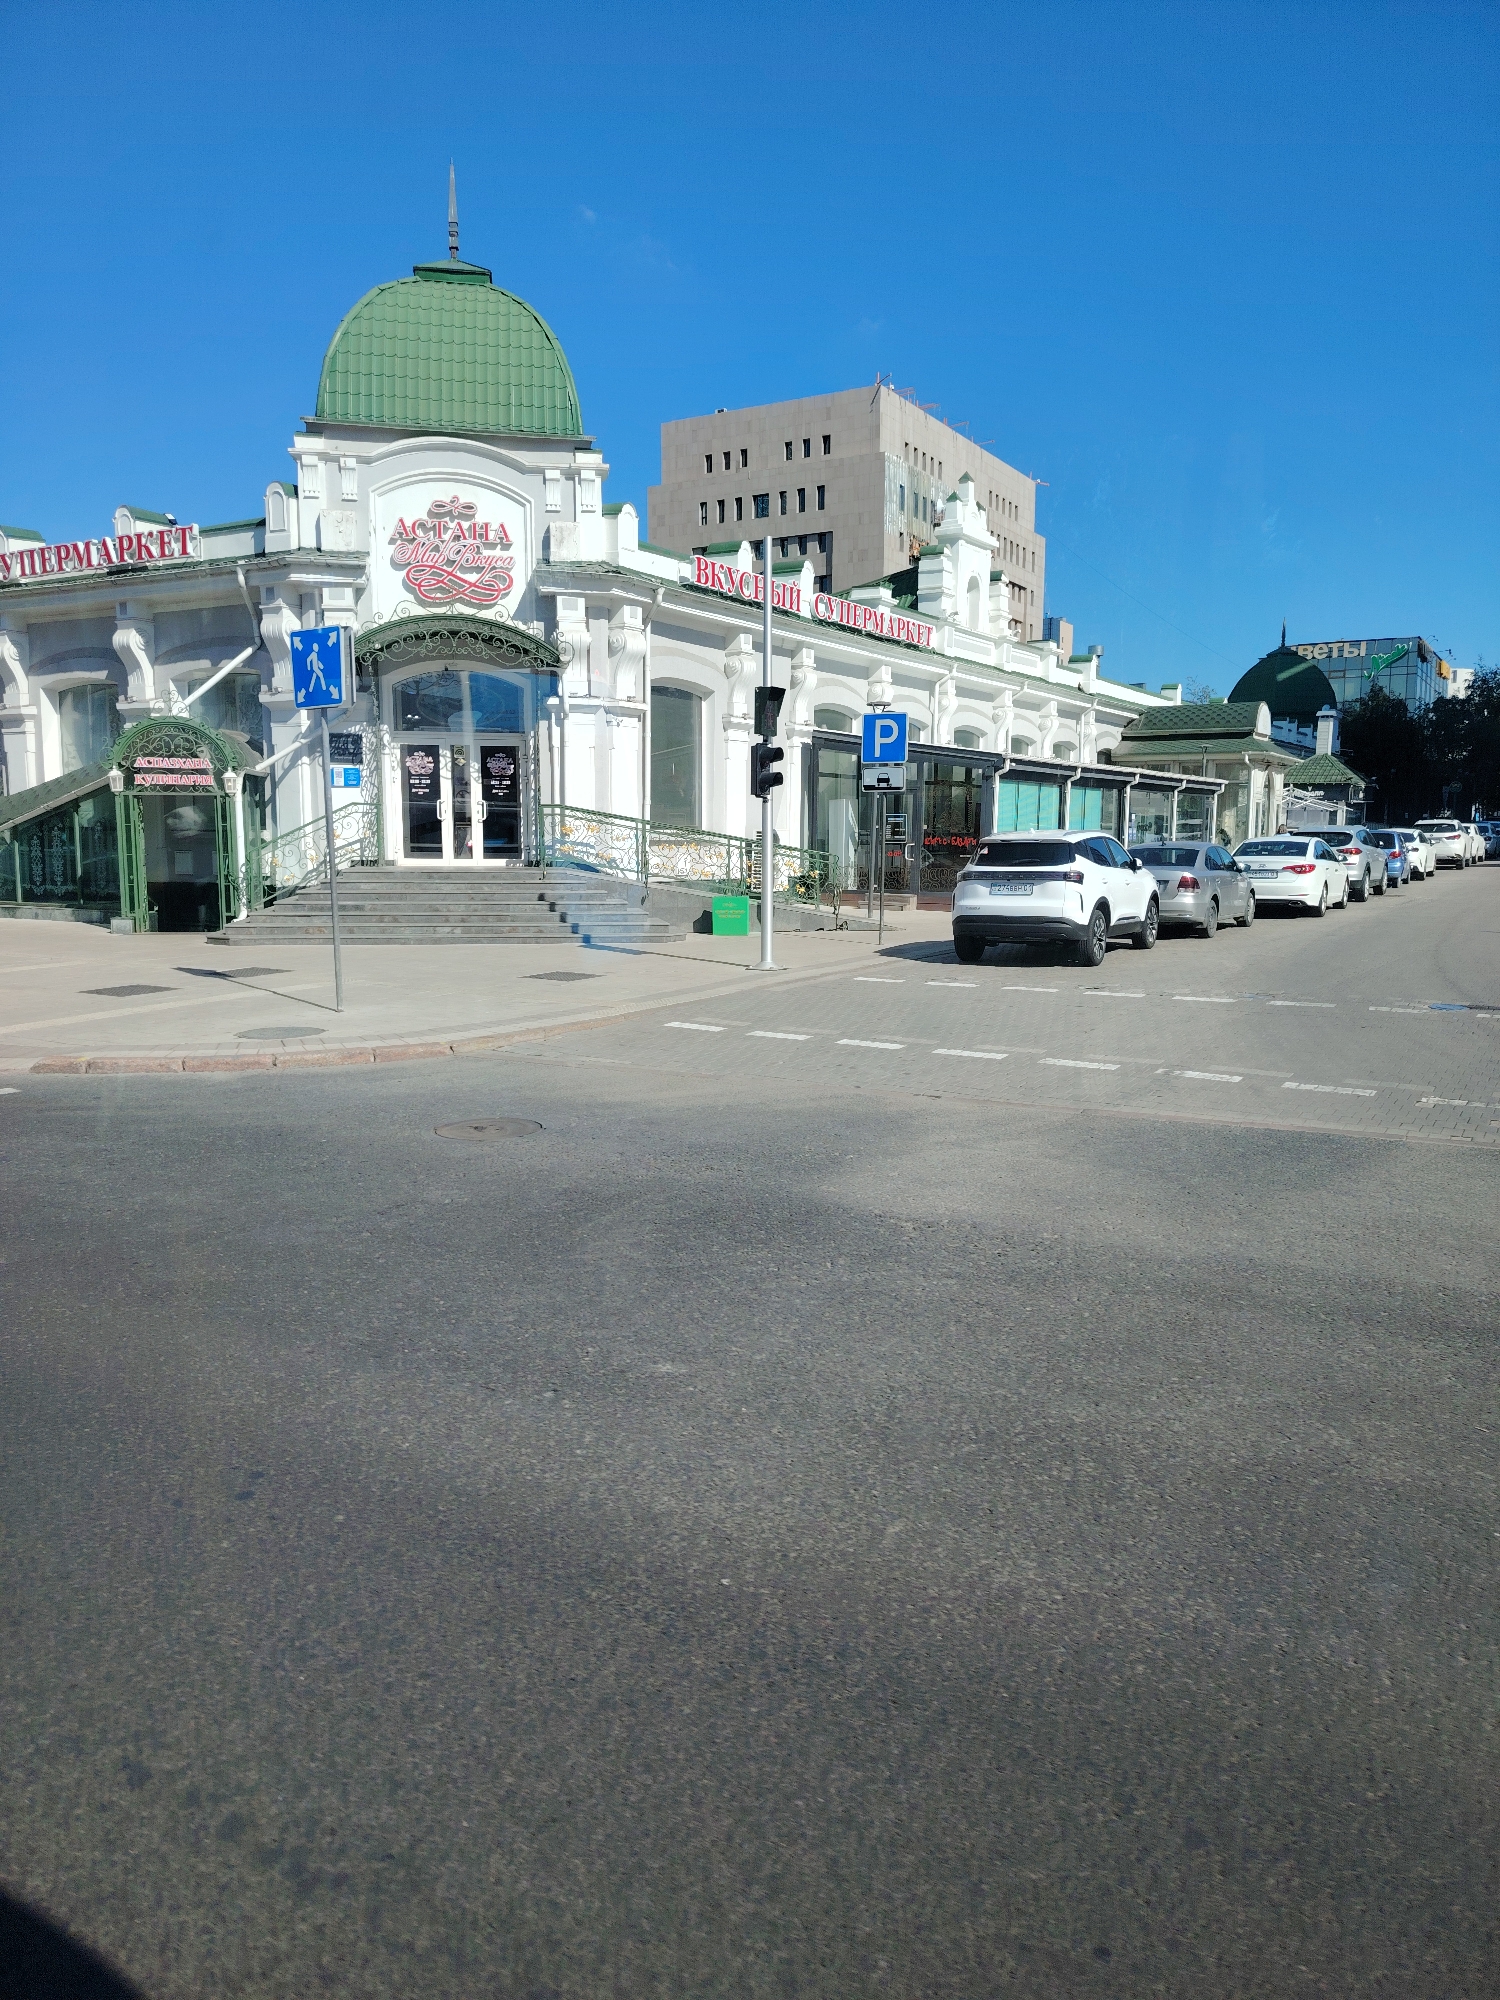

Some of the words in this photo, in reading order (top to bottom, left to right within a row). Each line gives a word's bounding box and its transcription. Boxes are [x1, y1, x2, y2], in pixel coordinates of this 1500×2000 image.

[391, 517, 513, 543] АСТАНА
[393, 540, 447, 568] Мир
[448, 541, 516, 571] Вкуса
[695, 555, 802, 613] ВКУСНЫЙ
[814, 592, 934, 648] СУПЕРМАРКЕТ
[1291, 642, 1367, 660] веты
[875, 718, 899, 758] P
[134, 757, 212, 768] АСПАЗХАНА
[134, 774, 214, 786] КУЛИНАРИЯ
